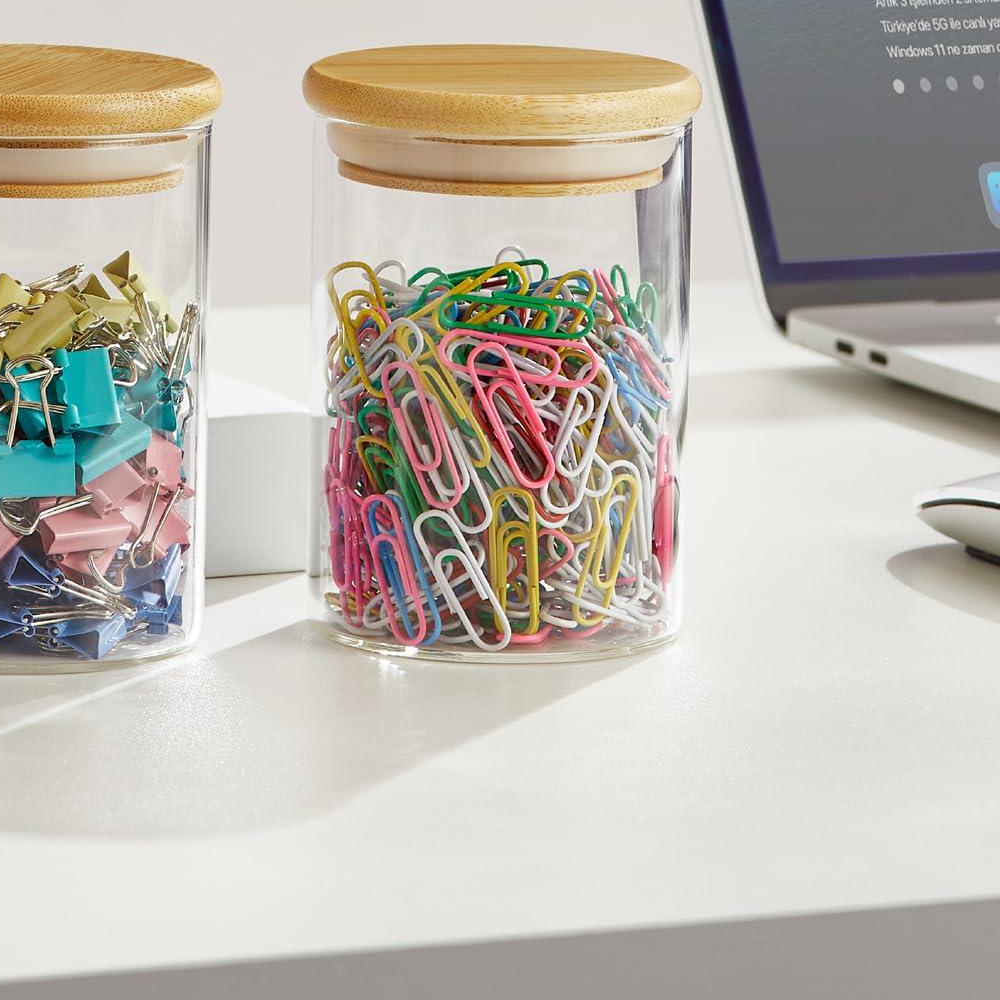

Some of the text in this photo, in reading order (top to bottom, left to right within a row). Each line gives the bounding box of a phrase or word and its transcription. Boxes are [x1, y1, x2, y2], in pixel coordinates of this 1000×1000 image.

[931, 17, 949, 32] 5G
[986, 16, 1000, 32] ya
[886, 44, 934, 58] Windows
[933, 43, 946, 57] 11
[947, 44, 961, 56] ne
[961, 43, 996, 55] zaman
